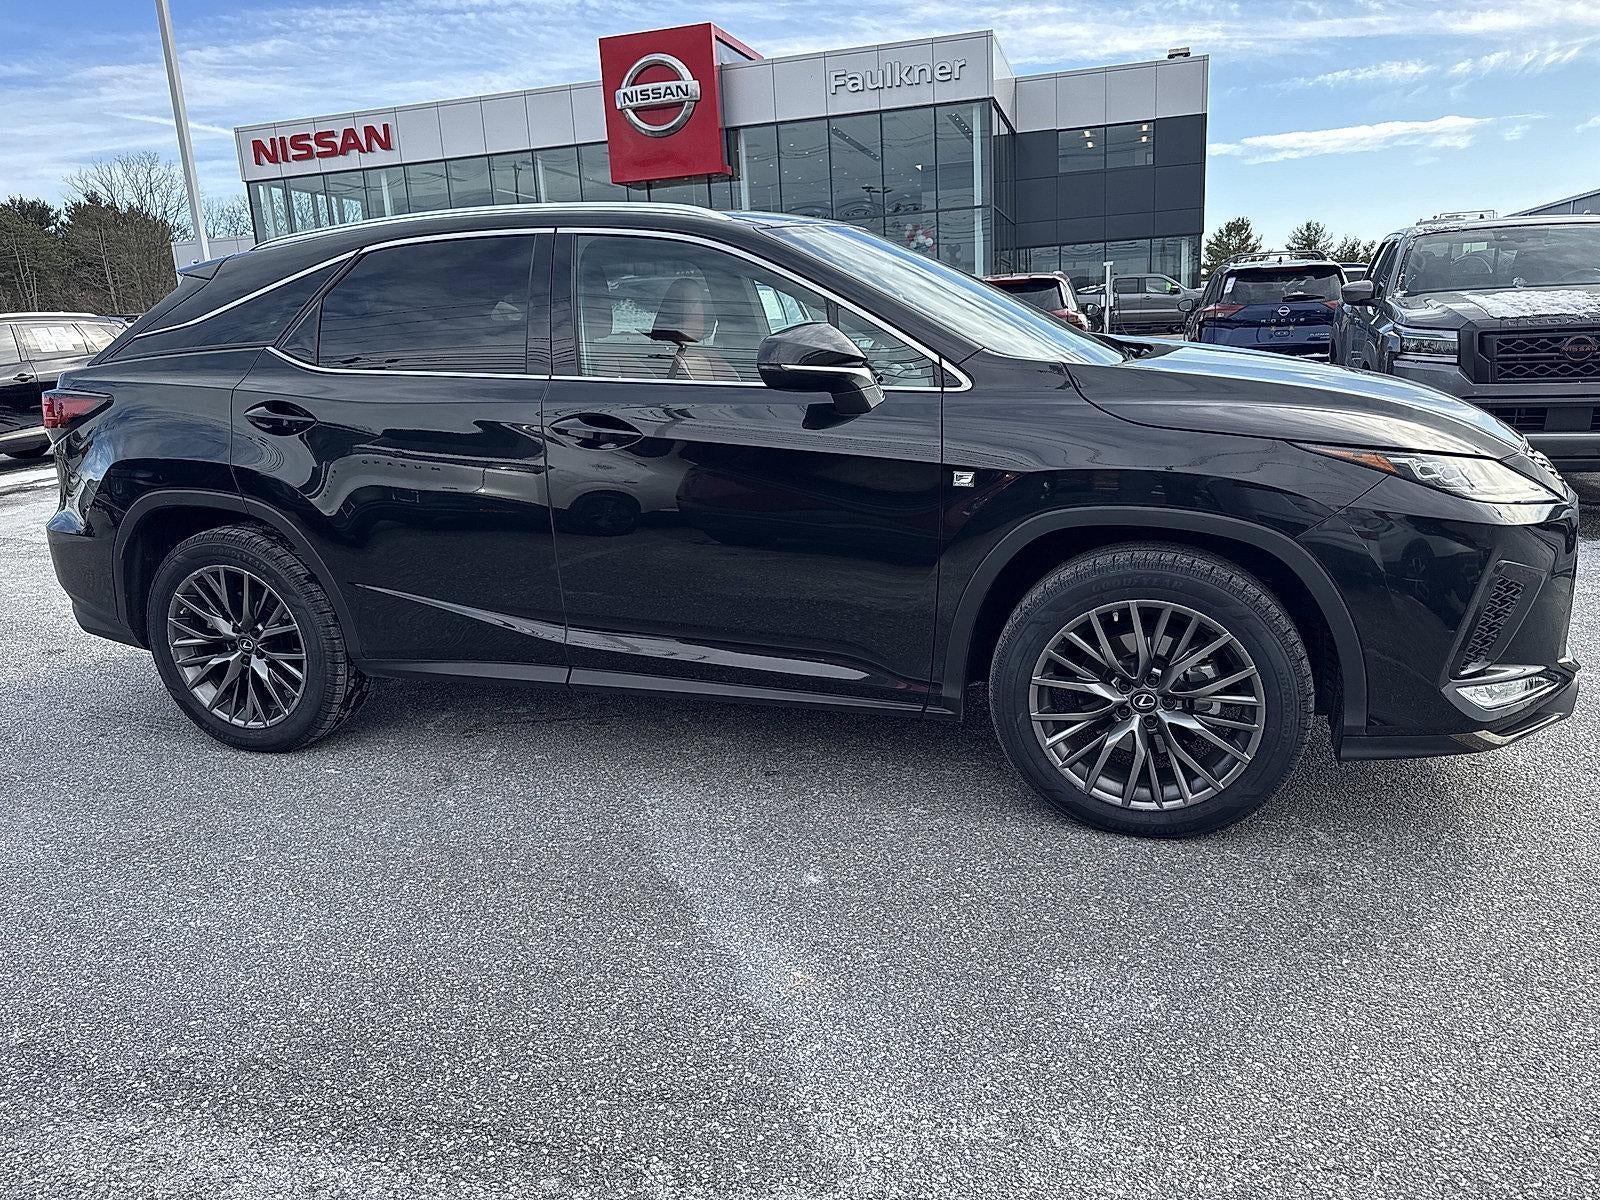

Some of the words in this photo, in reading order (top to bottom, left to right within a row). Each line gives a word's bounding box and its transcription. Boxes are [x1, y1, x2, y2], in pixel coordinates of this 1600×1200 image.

[622, 84, 689, 104] NISSAN
[829, 58, 967, 94] Faulkner
[251, 123, 394, 166] NISSAN
